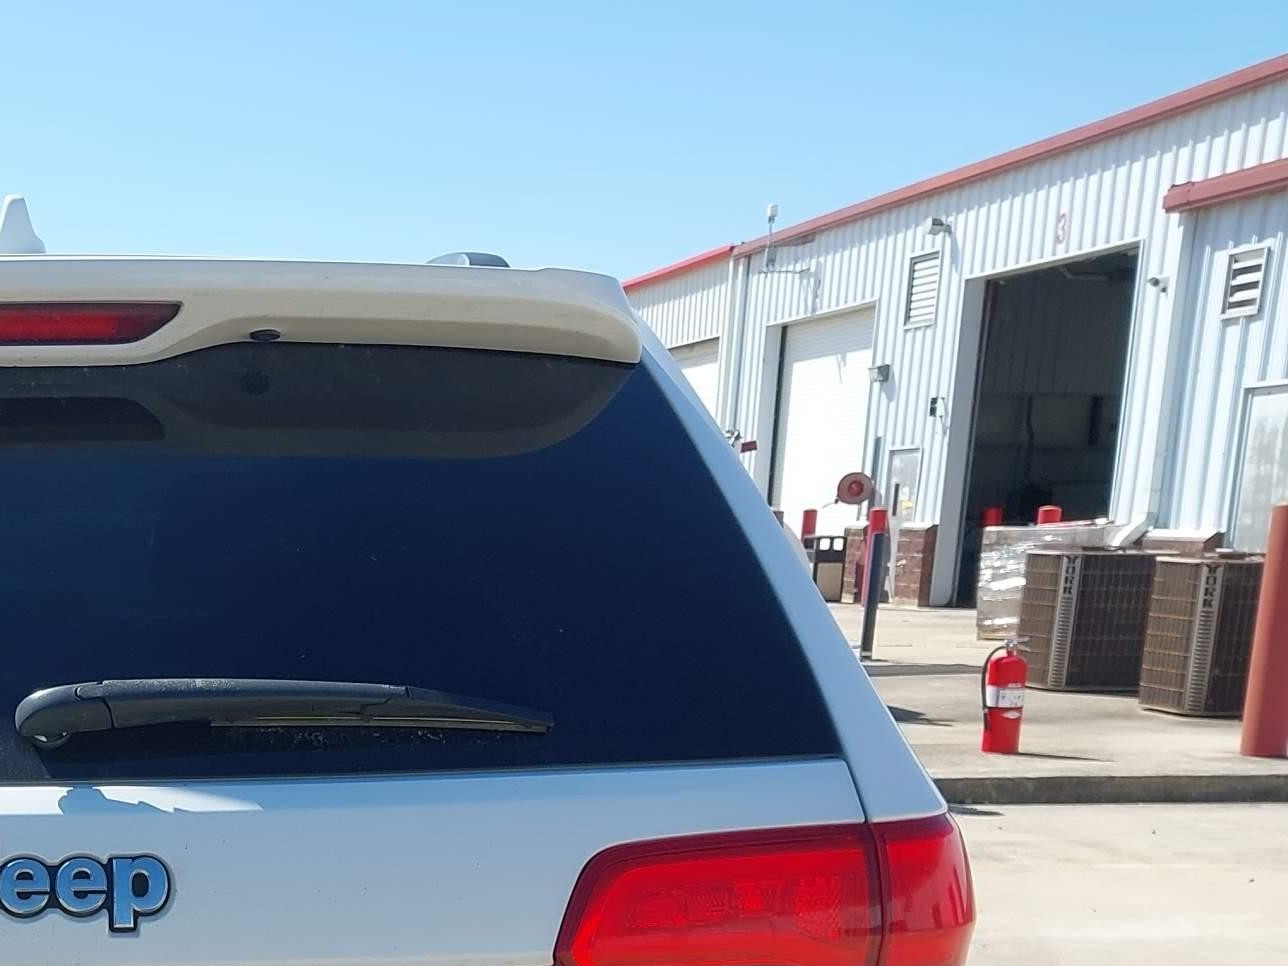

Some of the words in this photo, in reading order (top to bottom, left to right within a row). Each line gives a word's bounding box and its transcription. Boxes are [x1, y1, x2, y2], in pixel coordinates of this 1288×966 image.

[1056, 213, 1066, 244] 3
[1063, 556, 1080, 595] YORK
[1203, 565, 1222, 608] YORK
